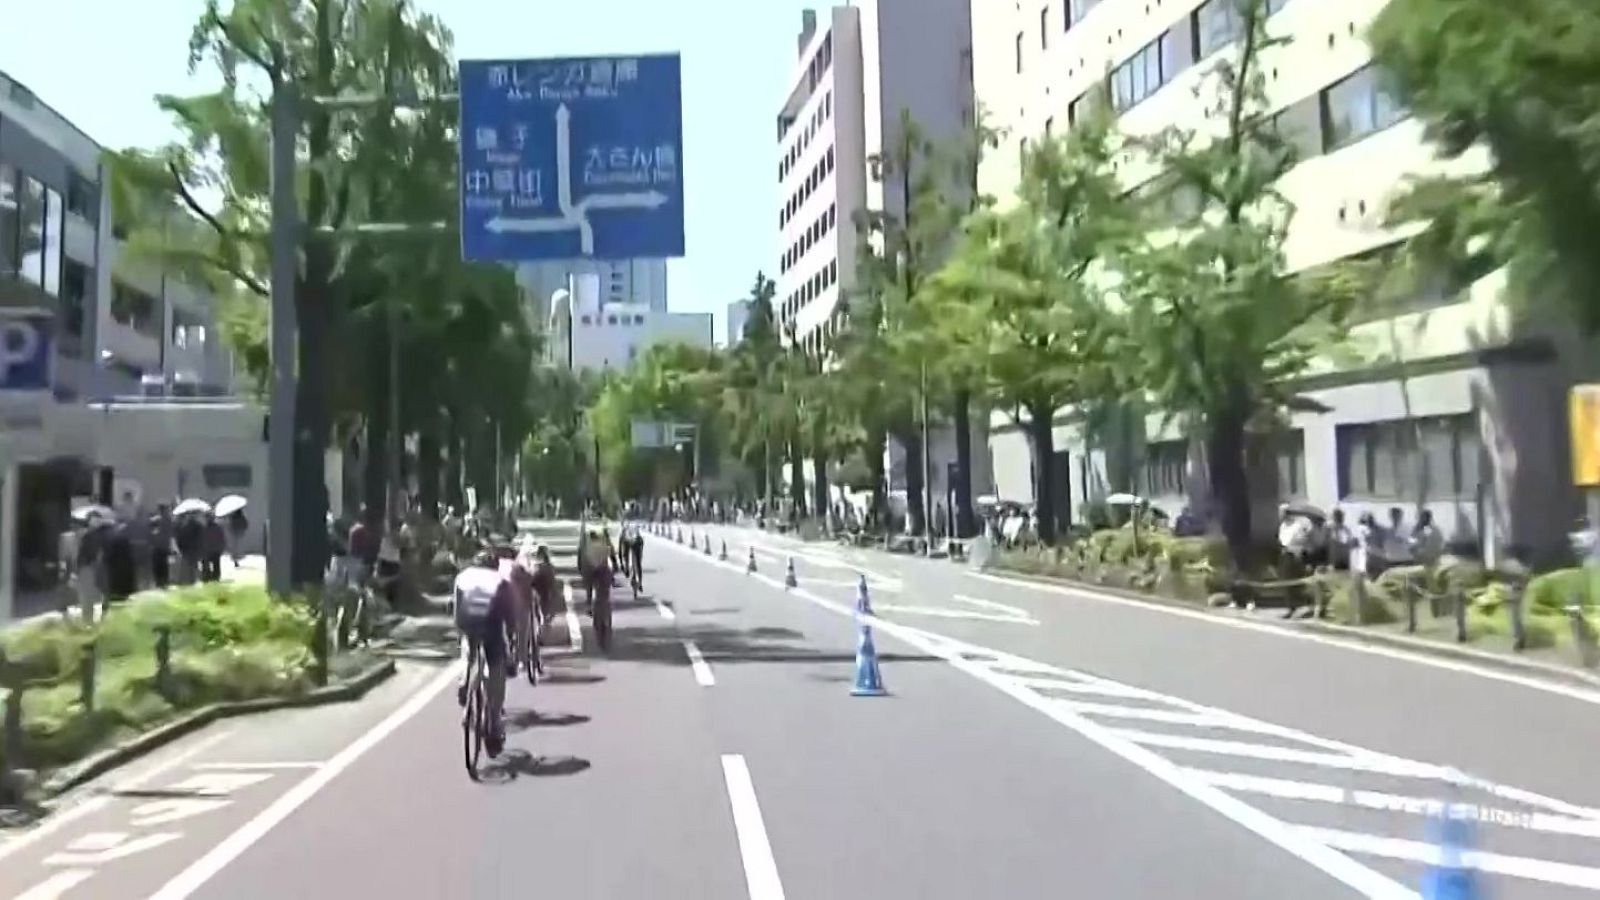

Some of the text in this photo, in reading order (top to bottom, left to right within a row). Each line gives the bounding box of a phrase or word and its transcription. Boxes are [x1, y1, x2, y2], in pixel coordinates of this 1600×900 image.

[488, 60, 638, 86] 赤レンガ
[465, 169, 541, 193] 中街
